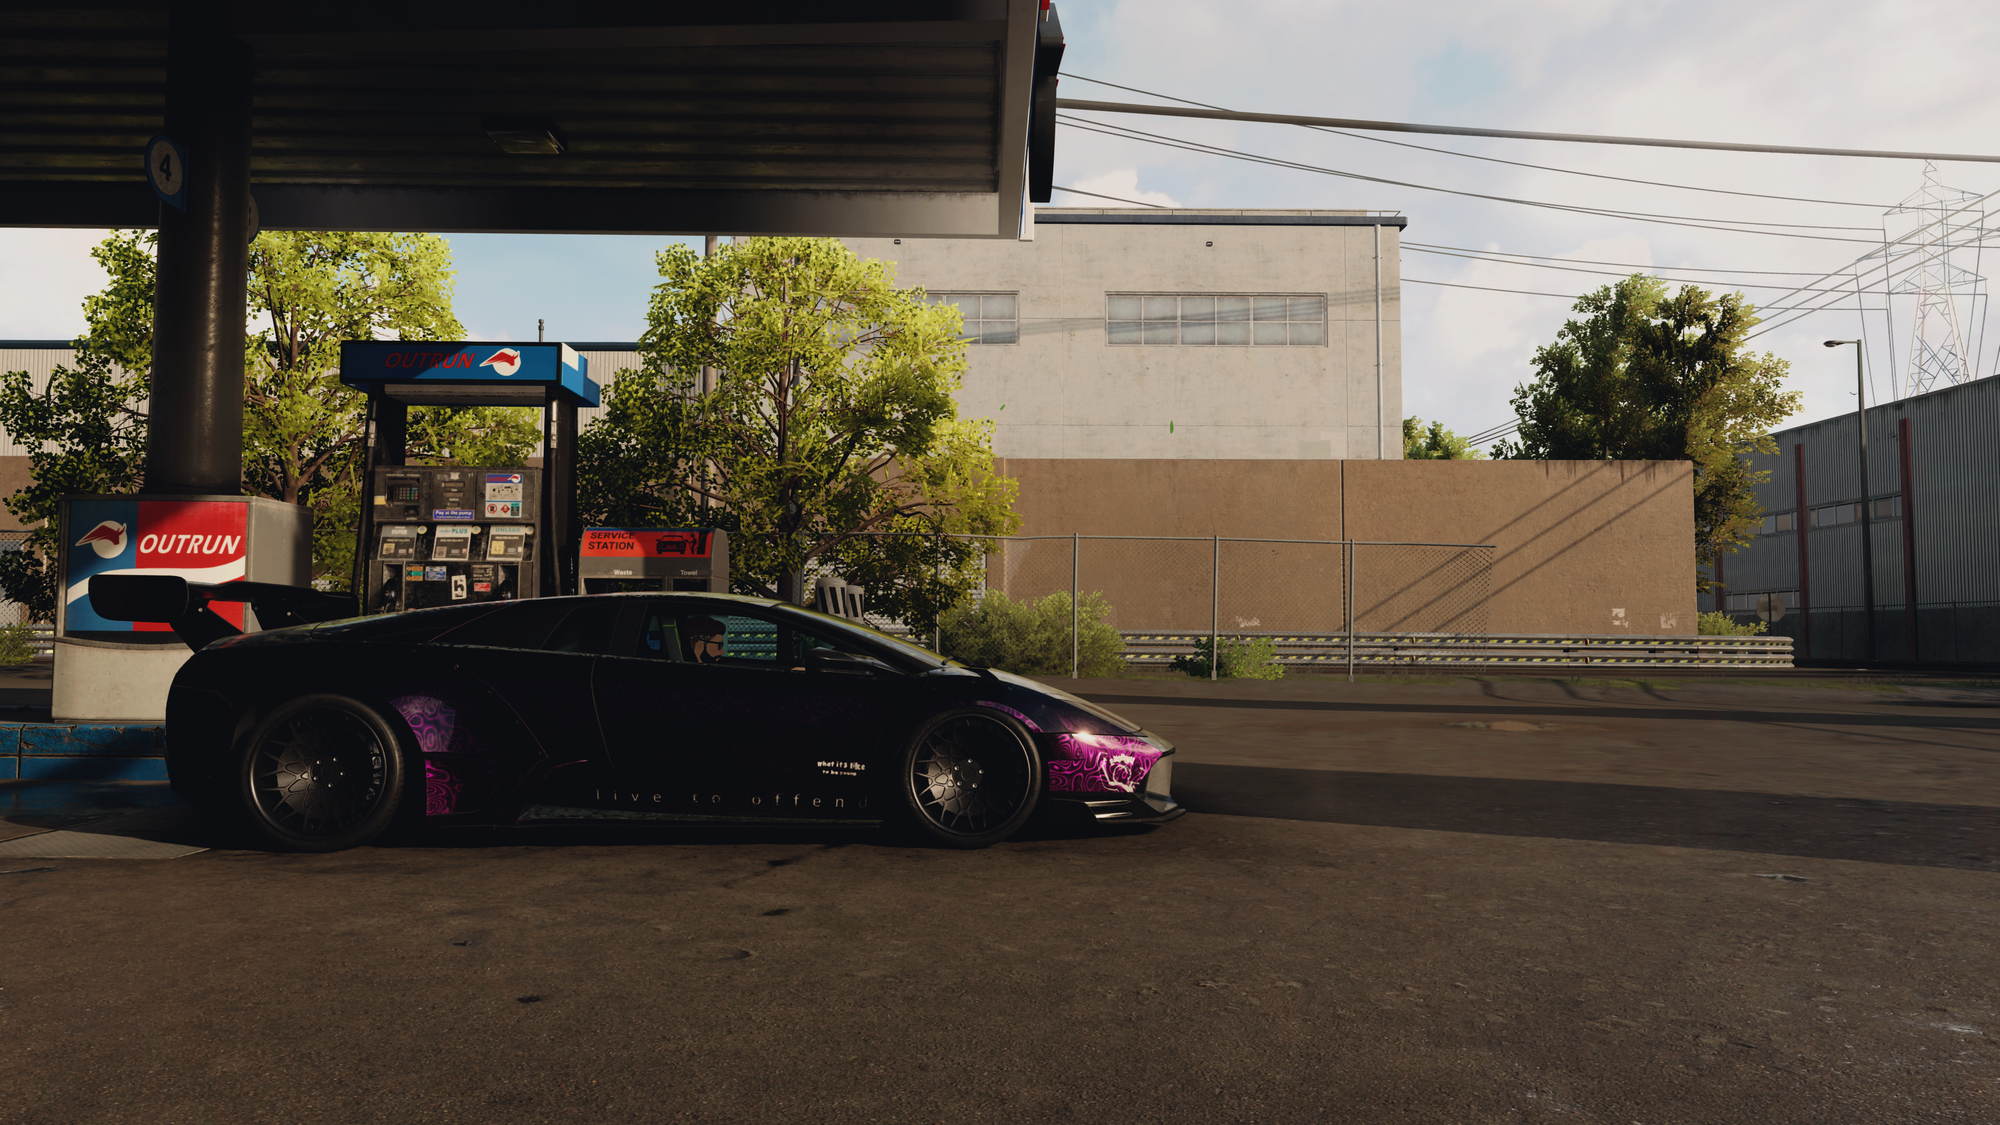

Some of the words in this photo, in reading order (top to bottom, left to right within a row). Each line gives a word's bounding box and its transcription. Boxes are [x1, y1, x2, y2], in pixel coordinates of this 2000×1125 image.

[159, 153, 172, 182] 4
[385, 352, 476, 369] OUTRUN
[139, 534, 241, 555] OUTRUN
[590, 532, 636, 540] SERVICE
[588, 541, 635, 550] STATION
[596, 788, 662, 803] live
[751, 793, 868, 808] offend
